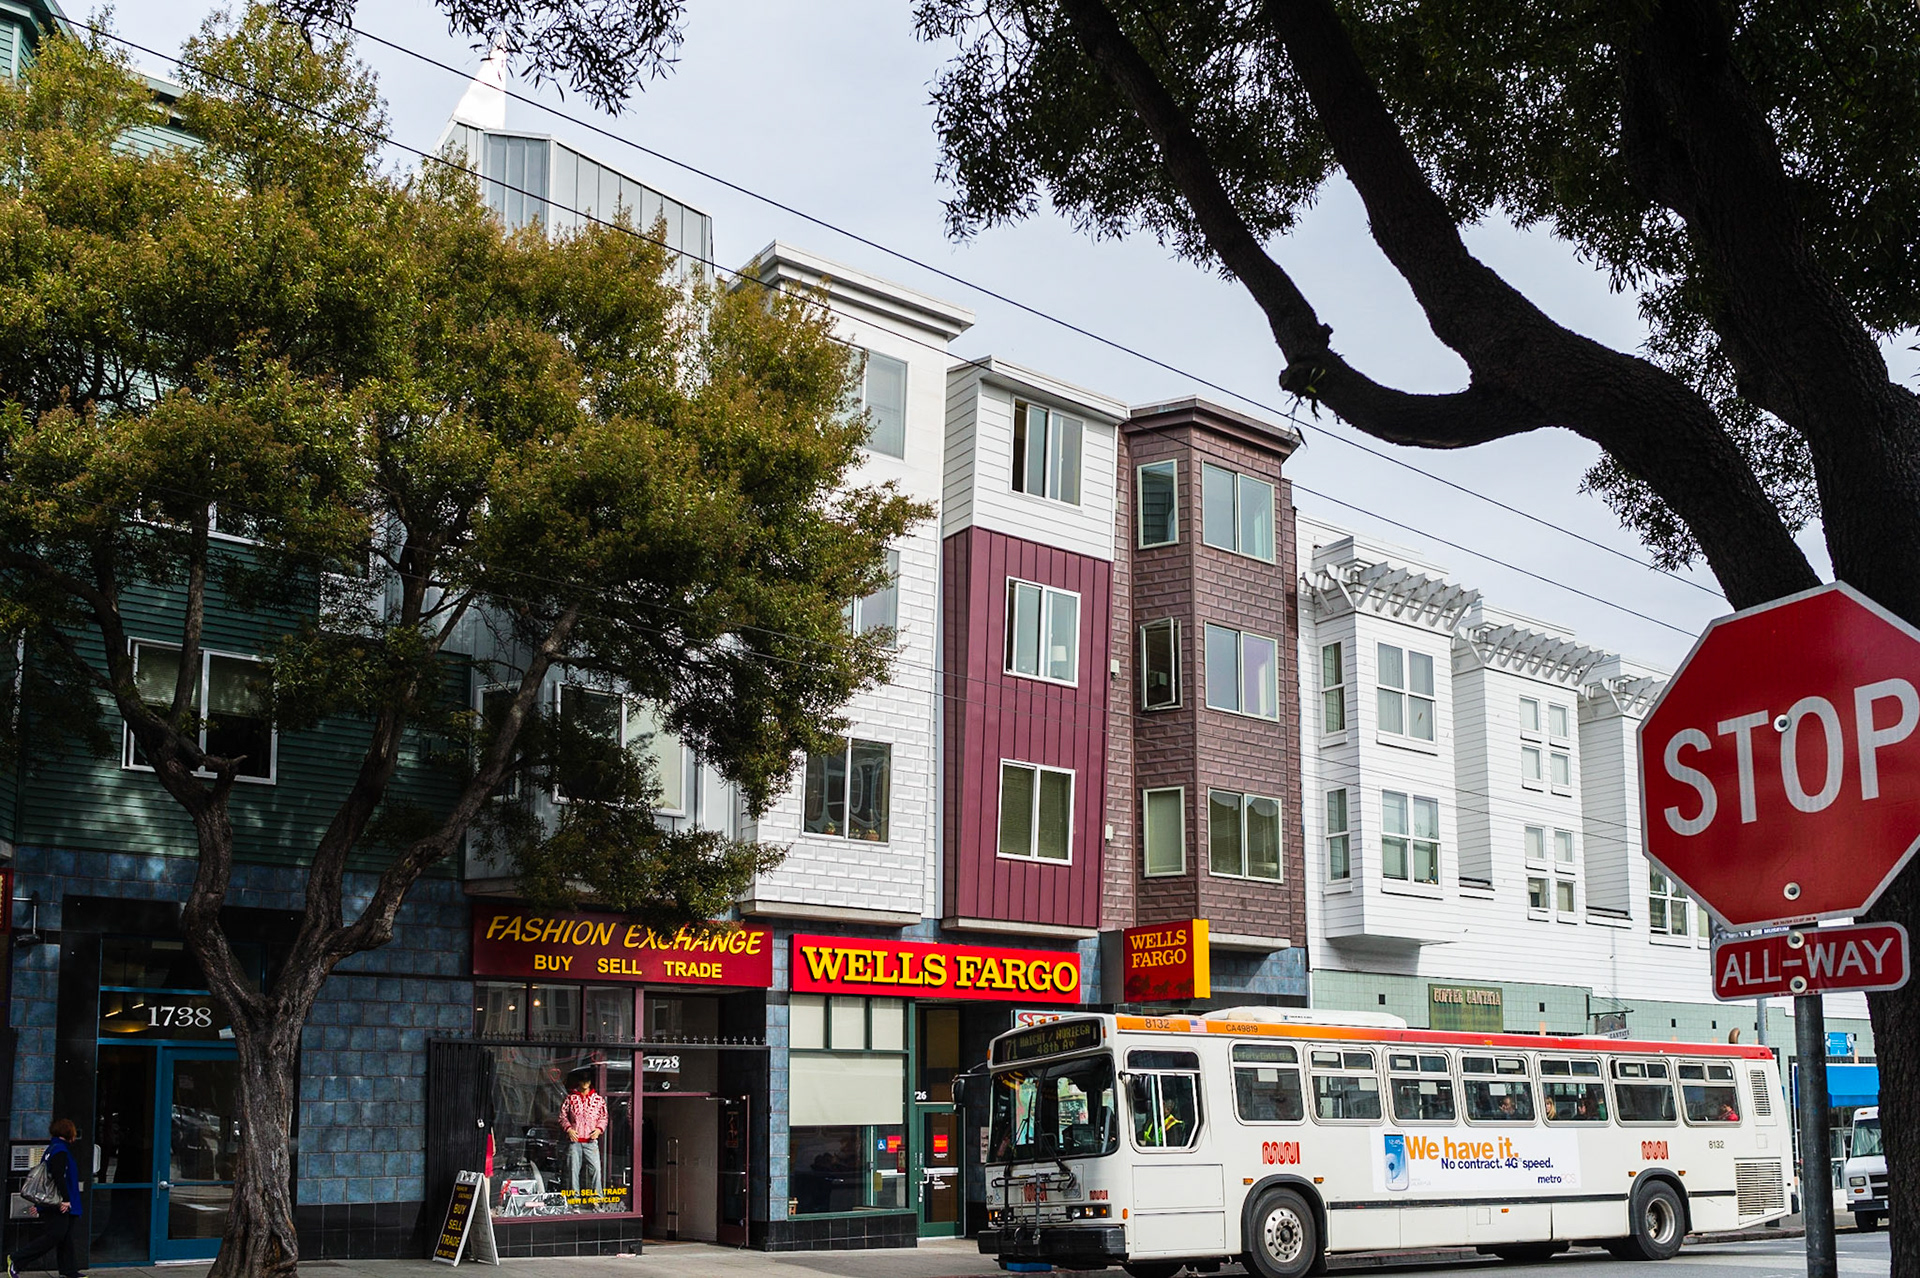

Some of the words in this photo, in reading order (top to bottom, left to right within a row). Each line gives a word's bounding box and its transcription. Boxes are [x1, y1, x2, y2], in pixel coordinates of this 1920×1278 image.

[1664, 678, 1919, 836] STOP
[485, 915, 616, 947] FASHION
[1130, 930, 1187, 950] WELLS
[534, 954, 574, 972] BUY
[597, 957, 643, 975] SELL
[663, 961, 723, 979] TRADE
[1132, 948, 1187, 968] FARGO
[1720, 937, 1894, 988] ALL-WAY
[802, 946, 947, 987] WELLS
[956, 955, 1079, 993] FARGO
[147, 1005, 213, 1028] 1738
[1145, 1019, 1170, 1029] 8132
[1226, 1024, 1258, 1033] CA49819
[648, 1055, 680, 1072] 1728
[1405, 1136, 1439, 1160] We
[1444, 1136, 1493, 1160] have
[1498, 1136, 1519, 1159] it.
[1708, 1140, 1725, 1149] 8132
[1441, 1158, 1455, 1169] No
[1457, 1158, 1503, 1169] contract.
[1522, 1157, 1554, 1171] speed.
[561, 1189, 575, 1197] BUY
[602, 1187, 627, 1196] TRADE
[453, 1203, 467, 1215] BUY
[448, 1219, 463, 1231] SELL
[441, 1234, 461, 1247] TRADE
